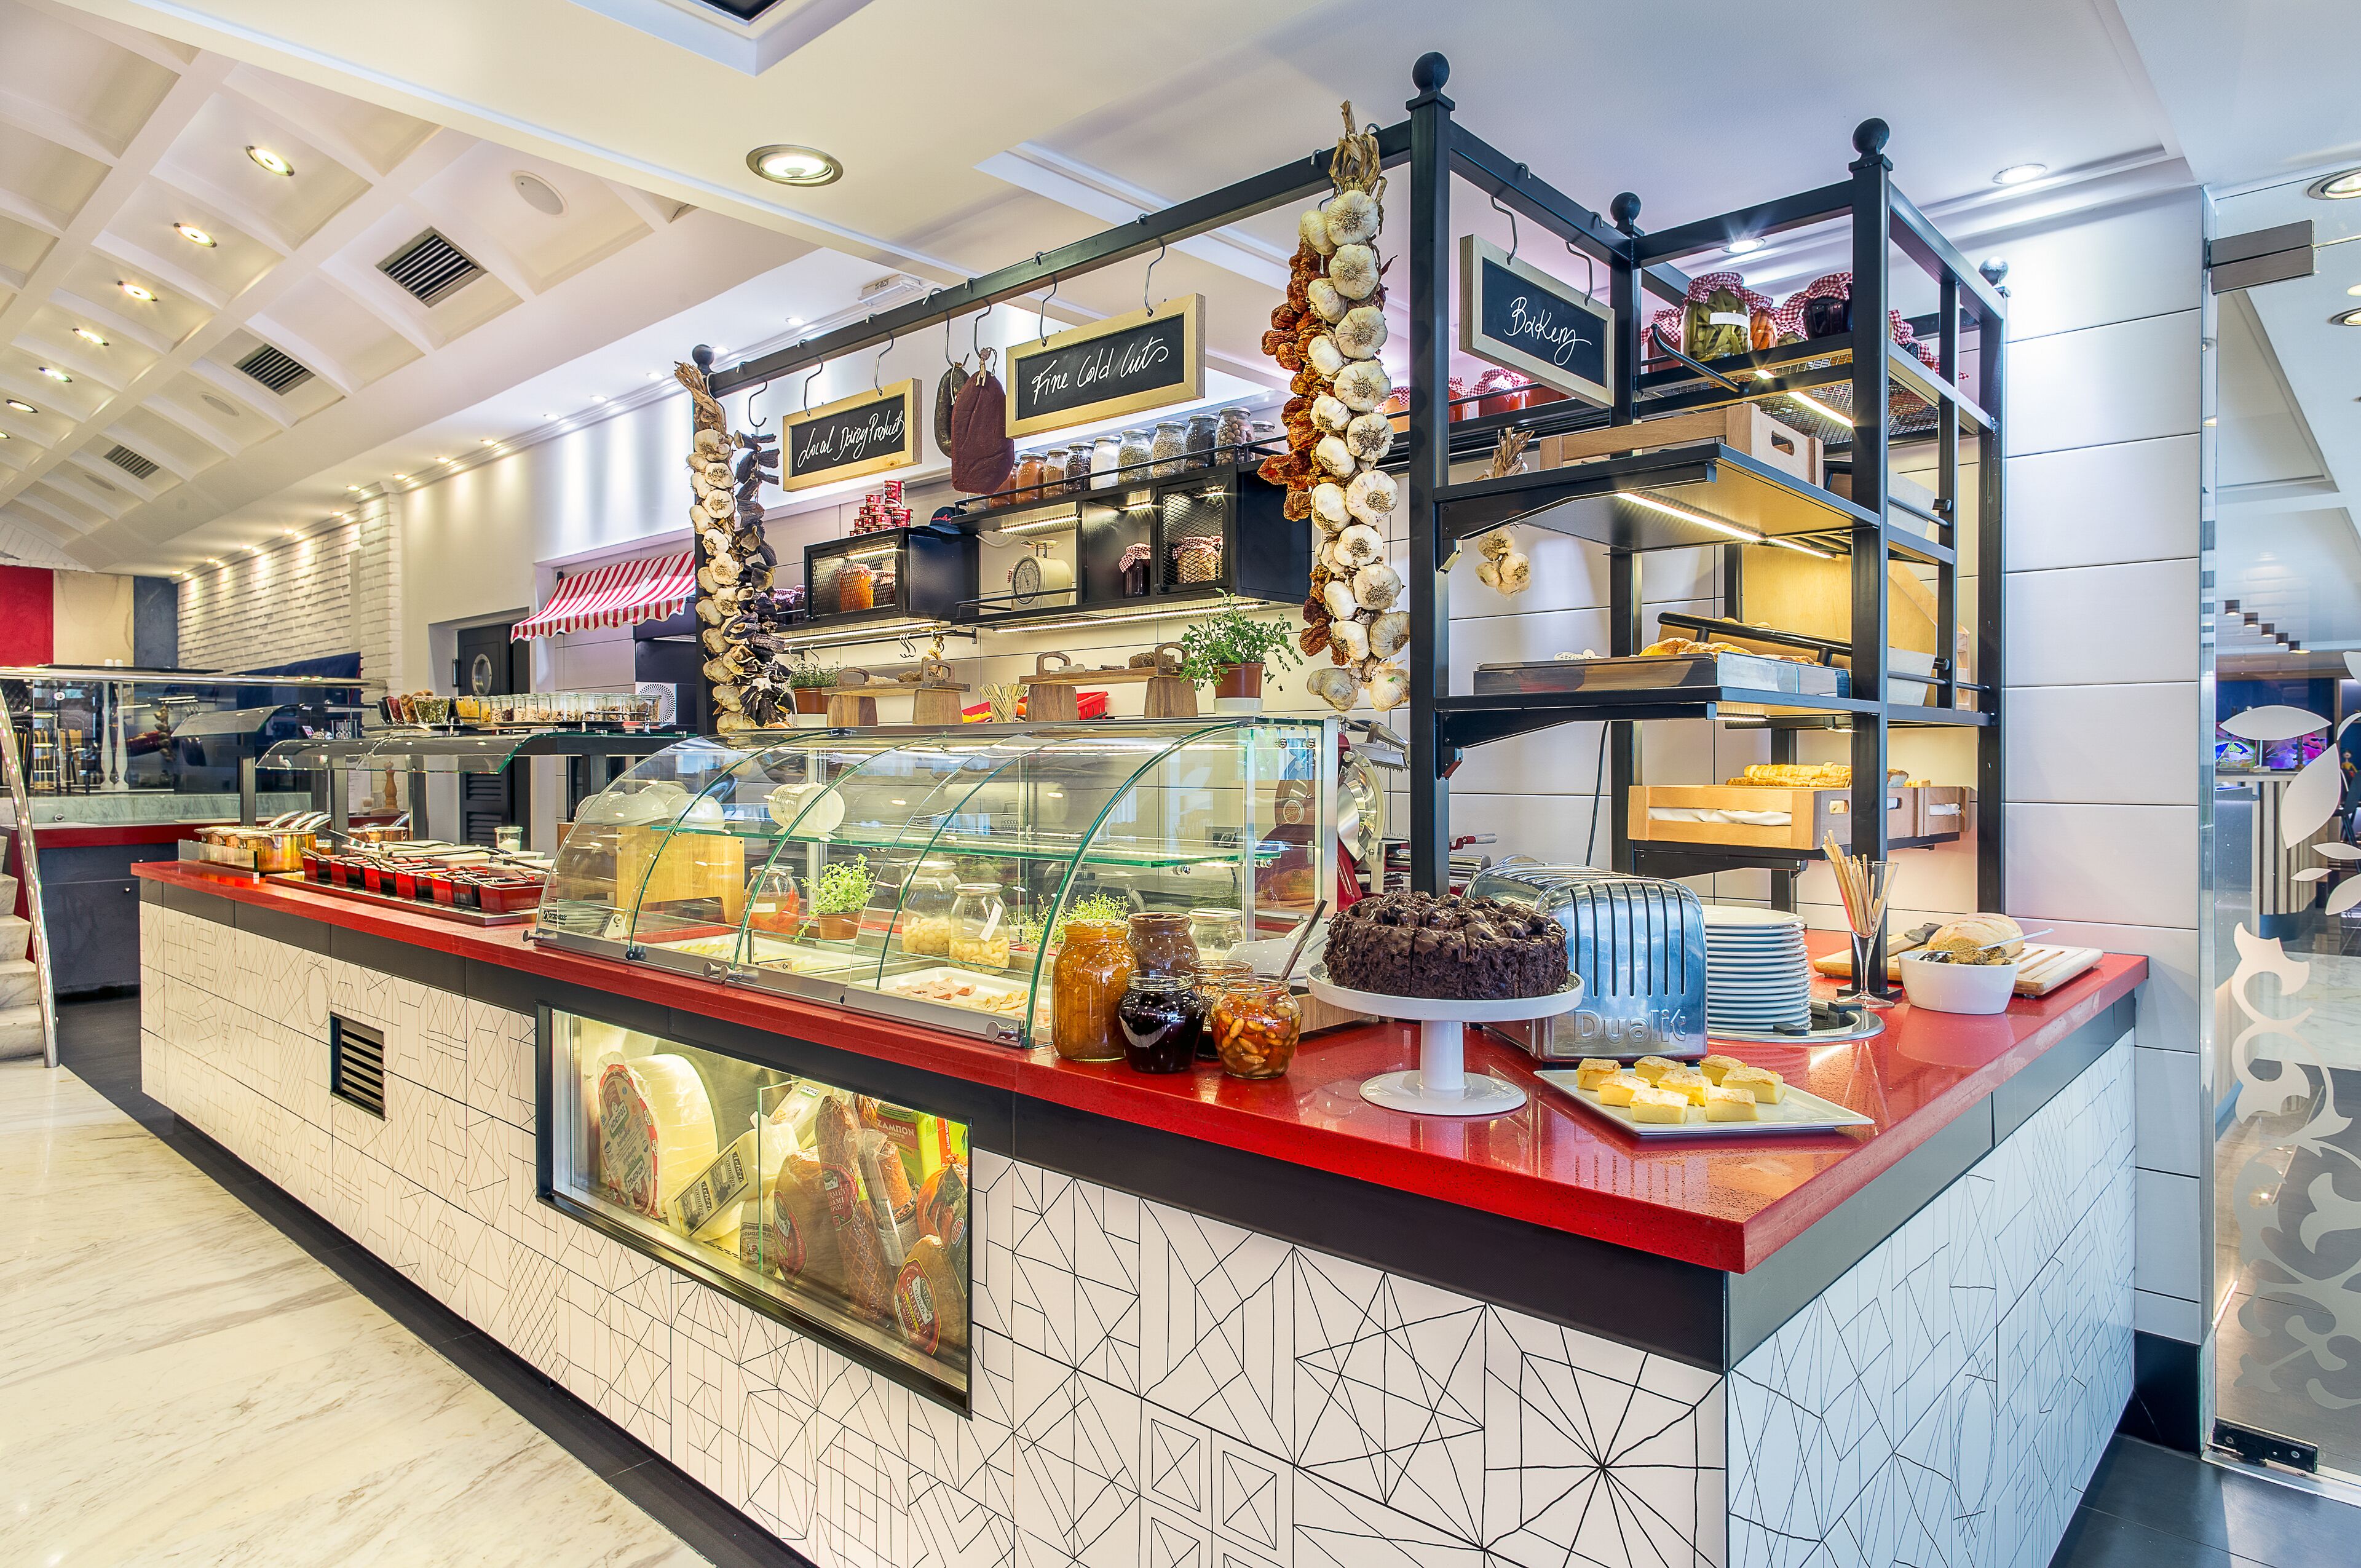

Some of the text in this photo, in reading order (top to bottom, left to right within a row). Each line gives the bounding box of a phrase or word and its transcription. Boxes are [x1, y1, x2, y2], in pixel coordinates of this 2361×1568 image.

[1504, 296, 1592, 365] Bakery
[1032, 336, 1168, 405] Fine Cold Cuts
[797, 410, 904, 468] Local Dairy Products
[1575, 1008, 1686, 1043] Dualit
[877, 1119, 916, 1137] ΖΑΜΠΟΝ
[906, 1277, 928, 1335] GOURMET
